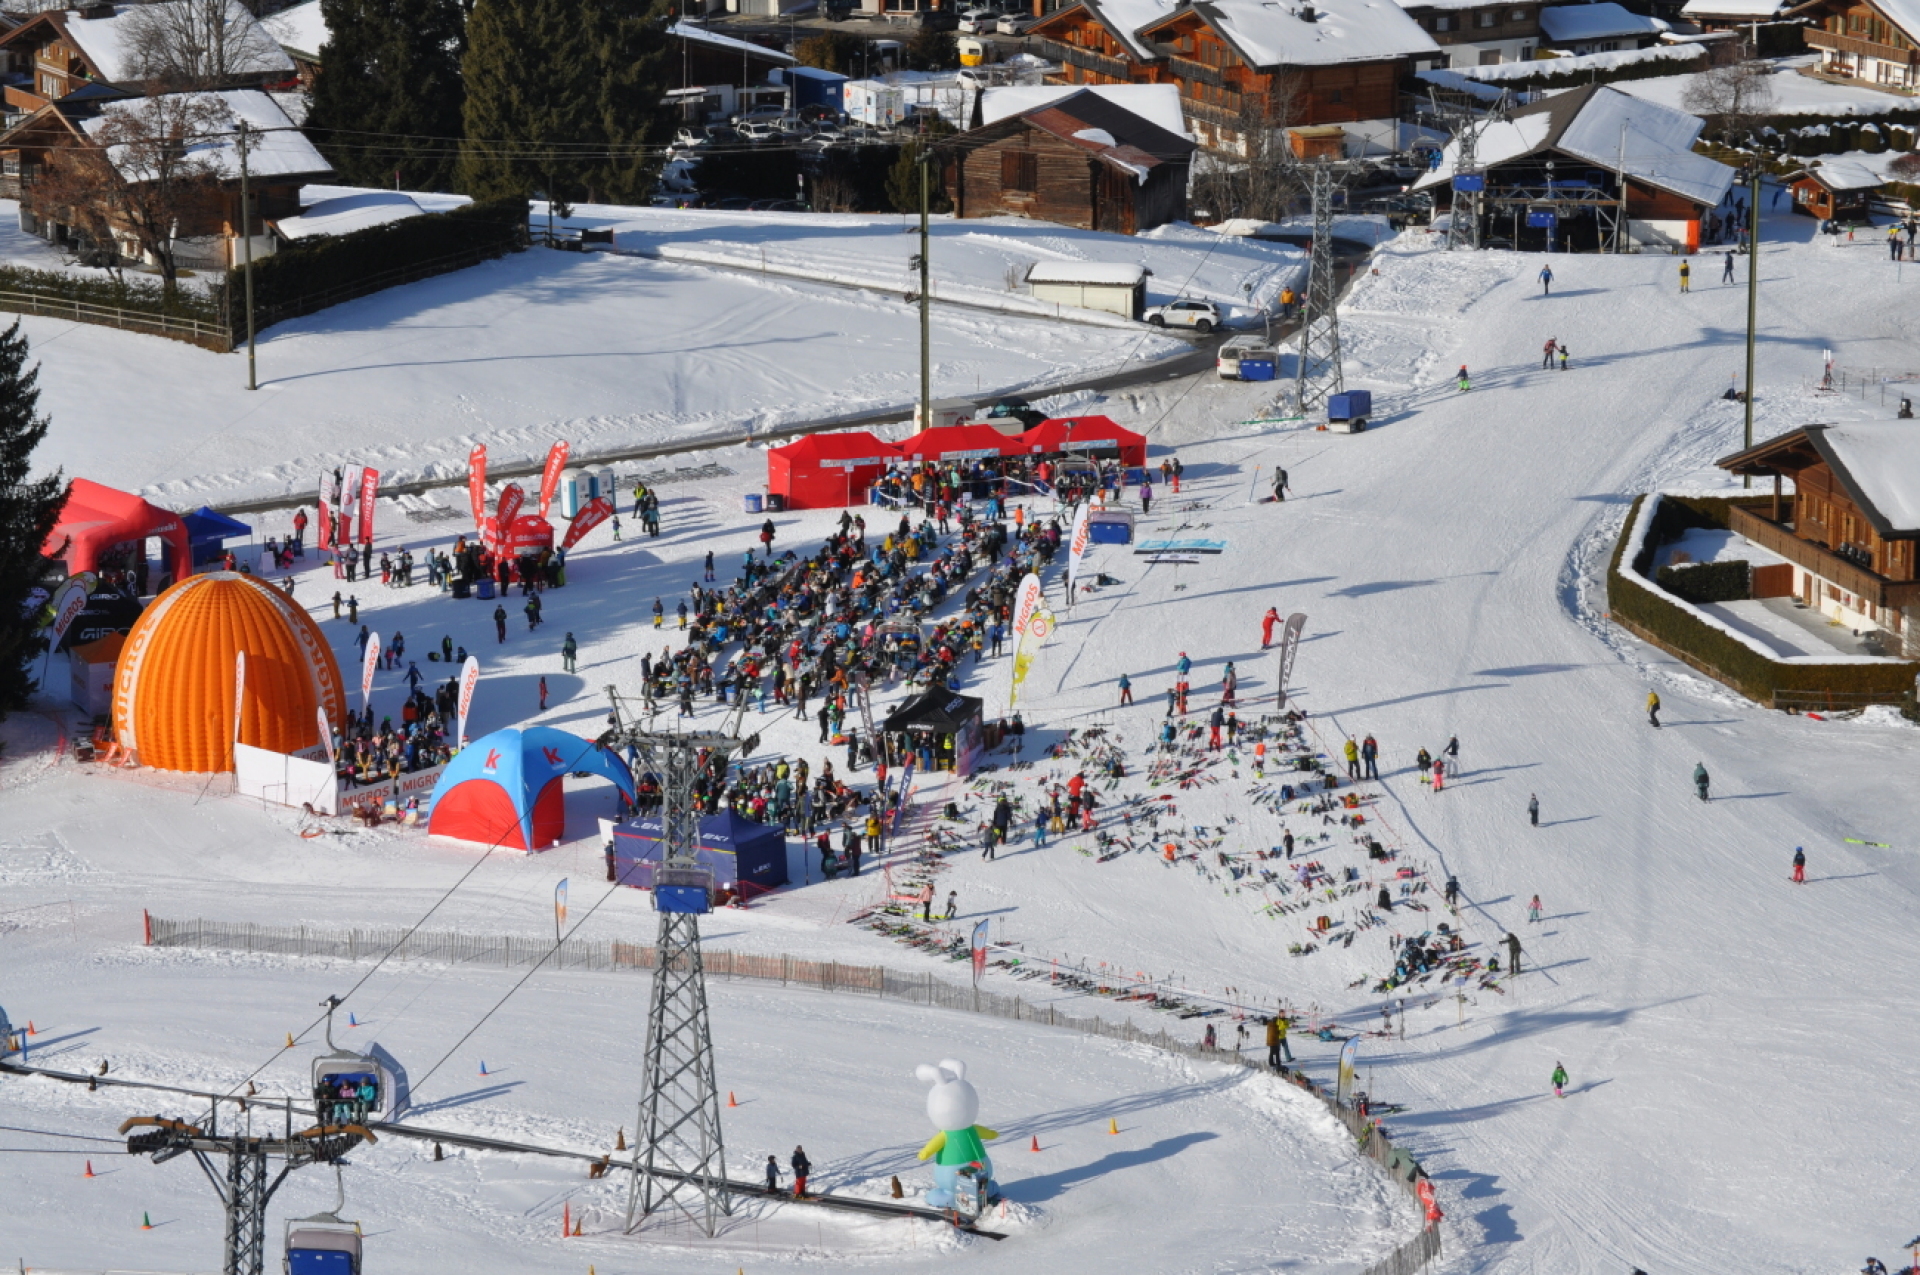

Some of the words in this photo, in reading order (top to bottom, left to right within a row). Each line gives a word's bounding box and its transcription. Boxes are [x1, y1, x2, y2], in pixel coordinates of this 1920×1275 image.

[55, 596, 84, 637] MIGROS
[1014, 583, 1038, 636] MIGROS
[117, 615, 156, 732] MIGROS
[286, 610, 338, 723] MIGROS
[362, 642, 378, 694] MIGROS
[459, 666, 478, 719] MIGROS
[342, 786, 390, 808] MIGROS
[403, 772, 441, 792] MIGRO
